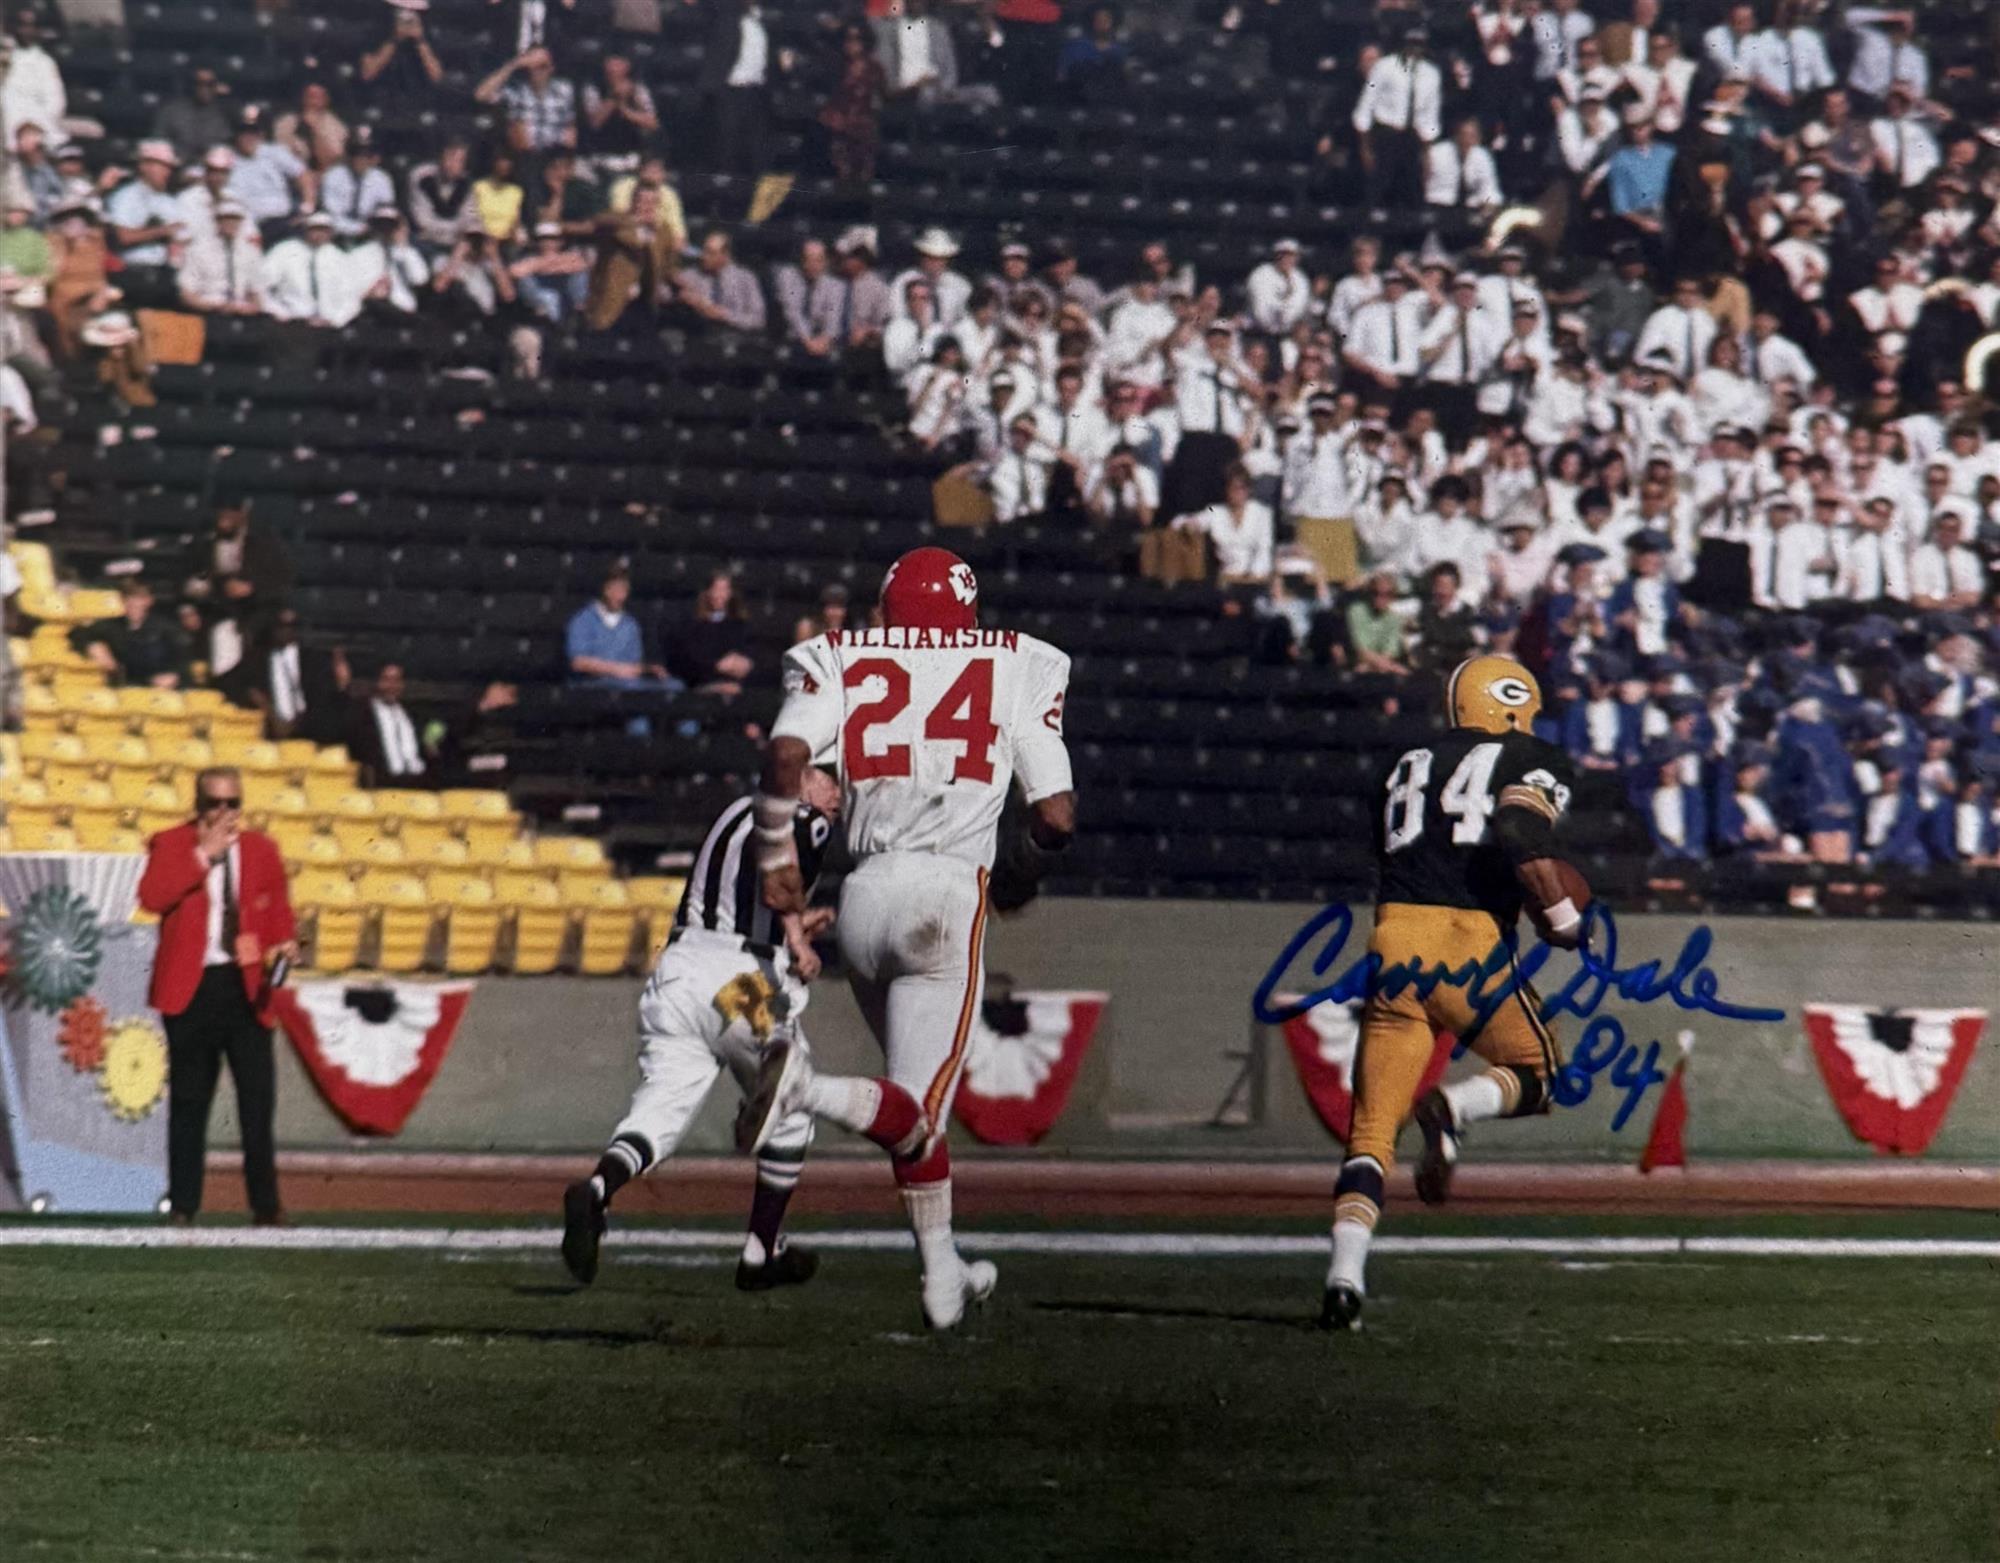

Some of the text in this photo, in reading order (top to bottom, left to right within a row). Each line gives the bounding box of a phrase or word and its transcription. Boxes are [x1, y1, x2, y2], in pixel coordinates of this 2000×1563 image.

[825, 626, 1019, 653] WILLIAMSON
[842, 657, 1000, 786] 24
[1384, 742, 1503, 854] 84
[1552, 1014, 1665, 1132] 84
